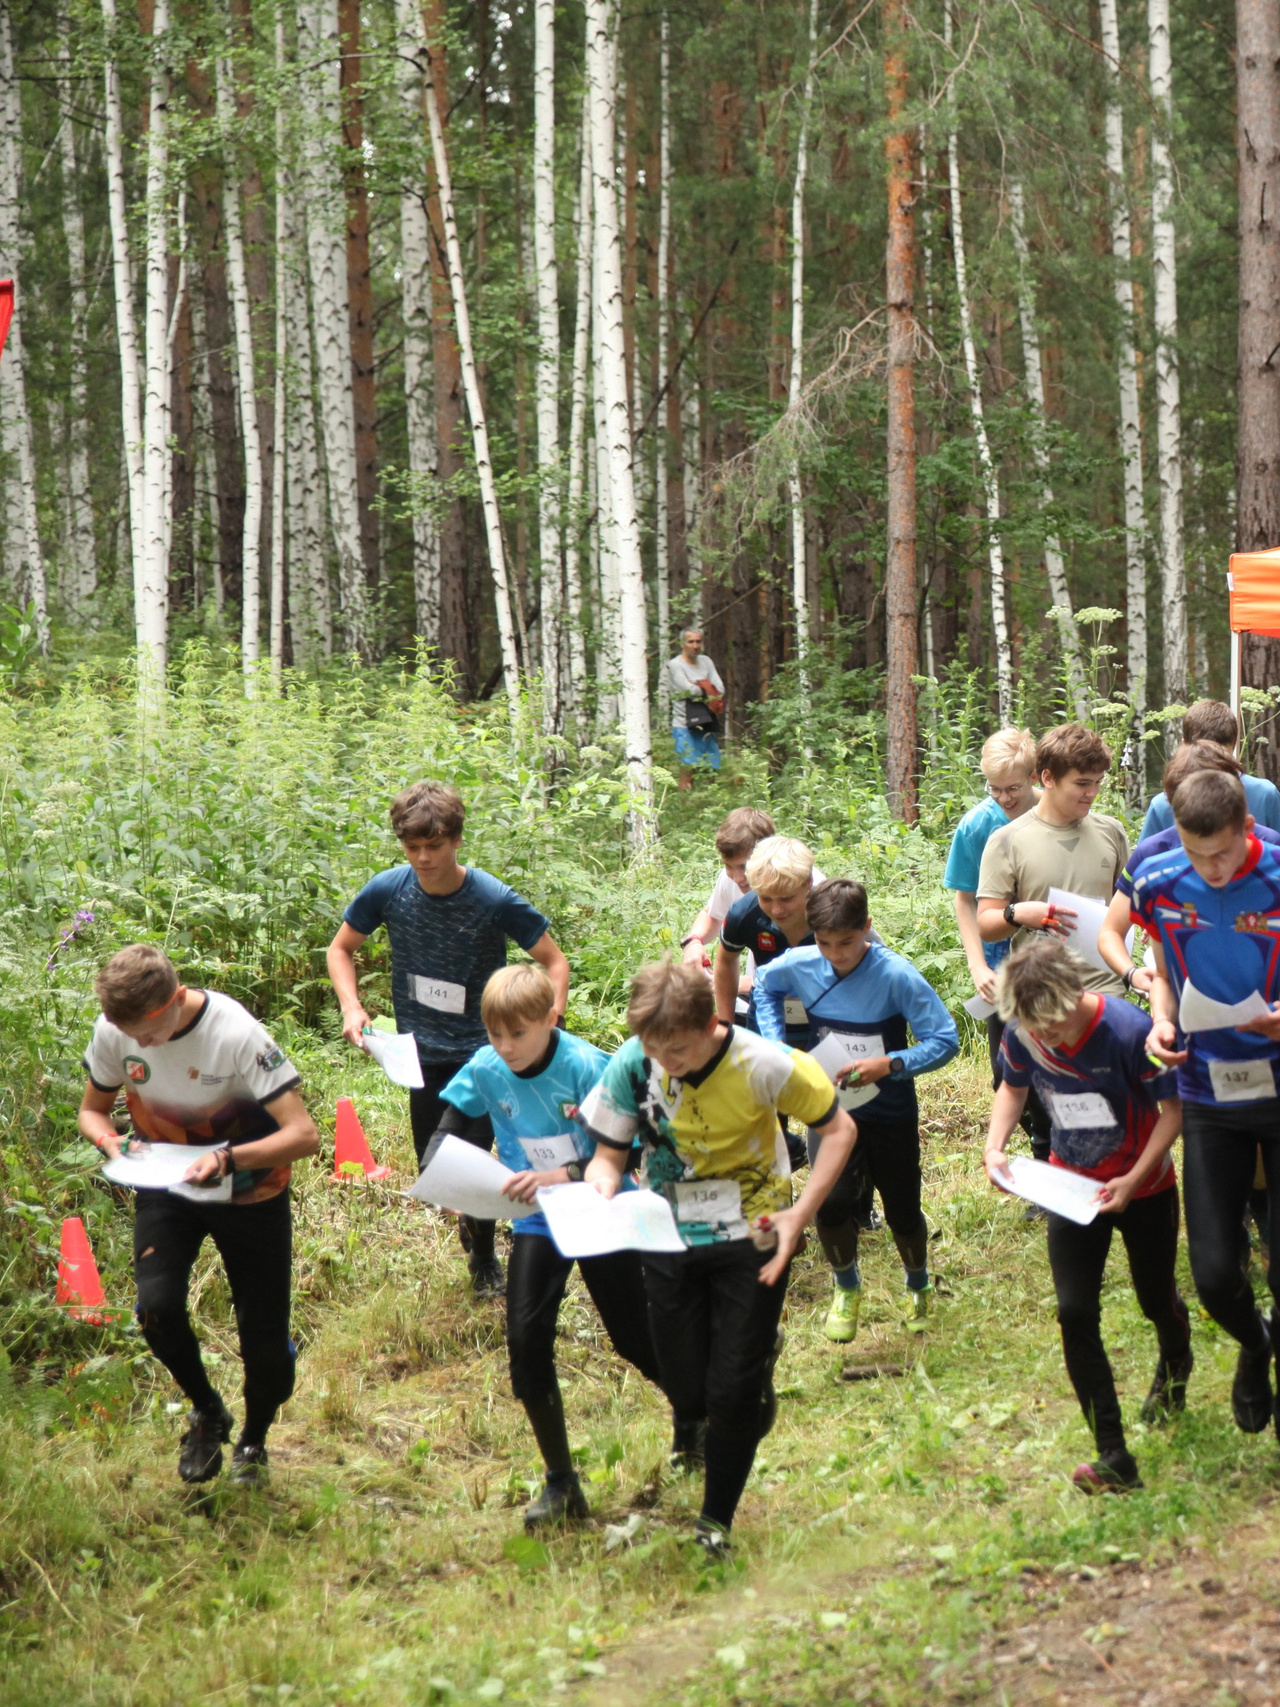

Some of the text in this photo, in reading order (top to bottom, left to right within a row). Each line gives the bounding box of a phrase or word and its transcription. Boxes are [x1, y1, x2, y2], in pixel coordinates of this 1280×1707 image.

[428, 986, 448, 999] 141
[844, 1042, 867, 1053] 143
[1223, 1071, 1249, 1083] 137
[533, 1147, 556, 1160] 133
